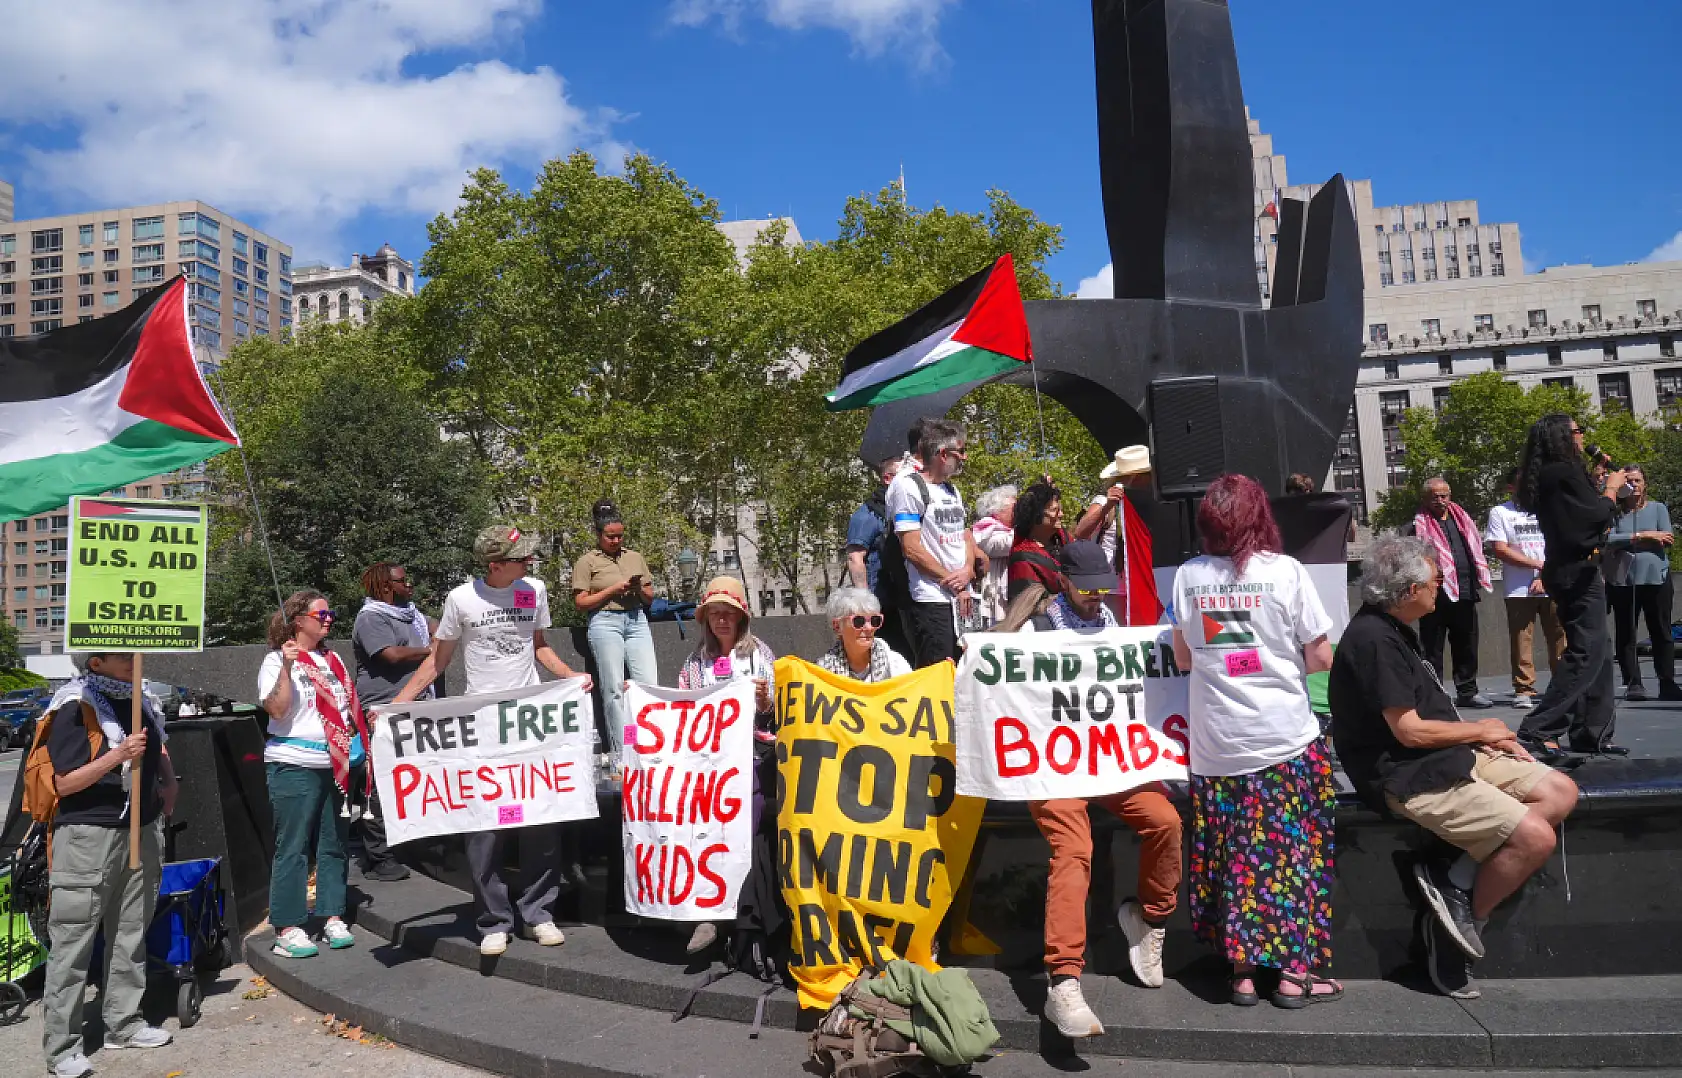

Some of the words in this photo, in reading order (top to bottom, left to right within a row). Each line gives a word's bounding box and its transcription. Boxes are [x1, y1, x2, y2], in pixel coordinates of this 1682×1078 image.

[81, 521, 140, 542] END
[149, 525, 199, 545] ALL
[79, 547, 138, 568] U.S.
[148, 551, 197, 570] AID
[123, 580, 157, 598] TO
[1193, 595, 1262, 609] GENOCIDE
[87, 601, 188, 622] ISRAEL
[89, 624, 182, 636] WORKERS.ORG
[71, 637, 123, 646] WORKERS
[126, 638, 163, 647] WORLD
[165, 638, 197, 647] PARTY
[973, 643, 1082, 685] SEND
[1093, 640, 1190, 683] BREA
[1052, 683, 1143, 722] NOT
[388, 711, 478, 758] FREE
[498, 699, 579, 744] FREE
[633, 698, 740, 754] STOP
[994, 714, 1190, 778] BOMBS
[392, 759, 575, 820] PALESTINE
[623, 765, 742, 825] KILLING
[635, 843, 730, 908] KIDS
